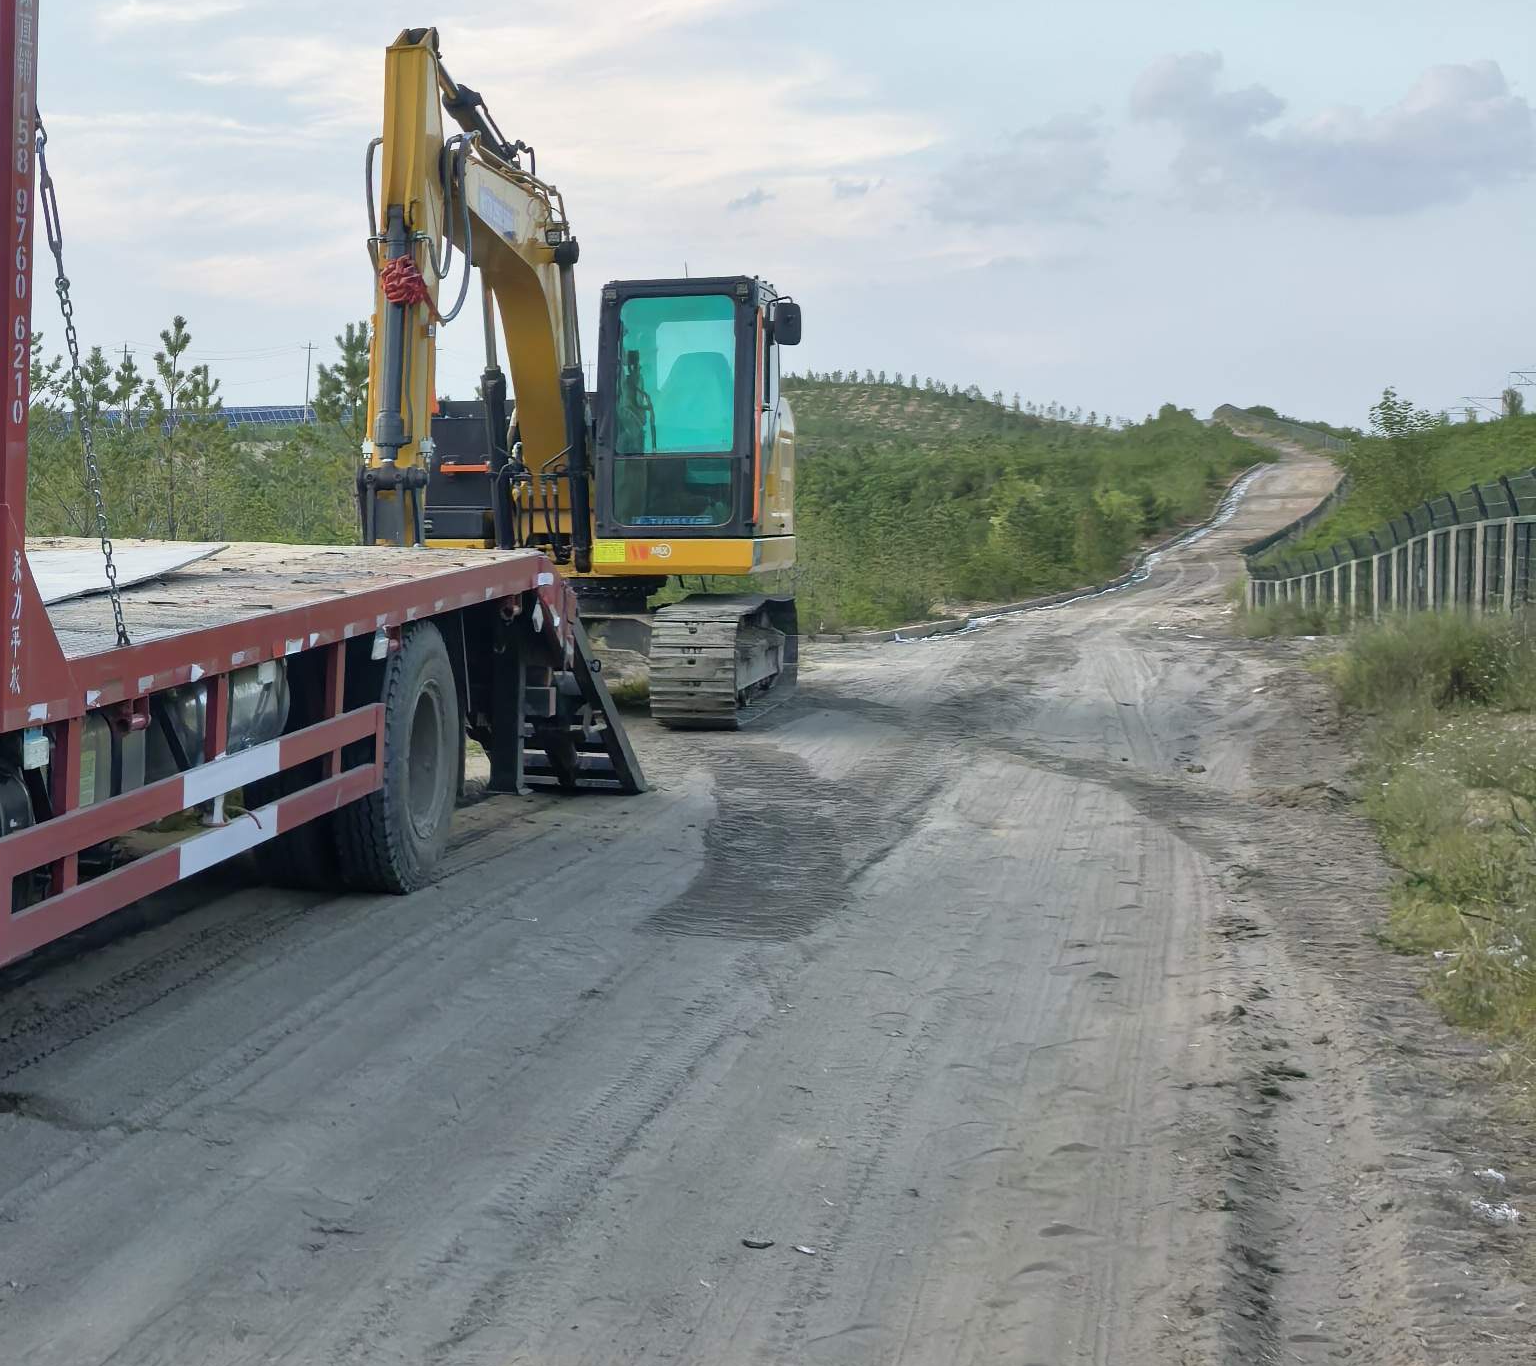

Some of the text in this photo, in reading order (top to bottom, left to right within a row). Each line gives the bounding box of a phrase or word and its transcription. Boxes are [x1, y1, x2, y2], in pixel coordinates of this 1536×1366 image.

[17, 91, 30, 174] 158
[15, 188, 29, 299] 9760
[13, 315, 25, 425] 6210
